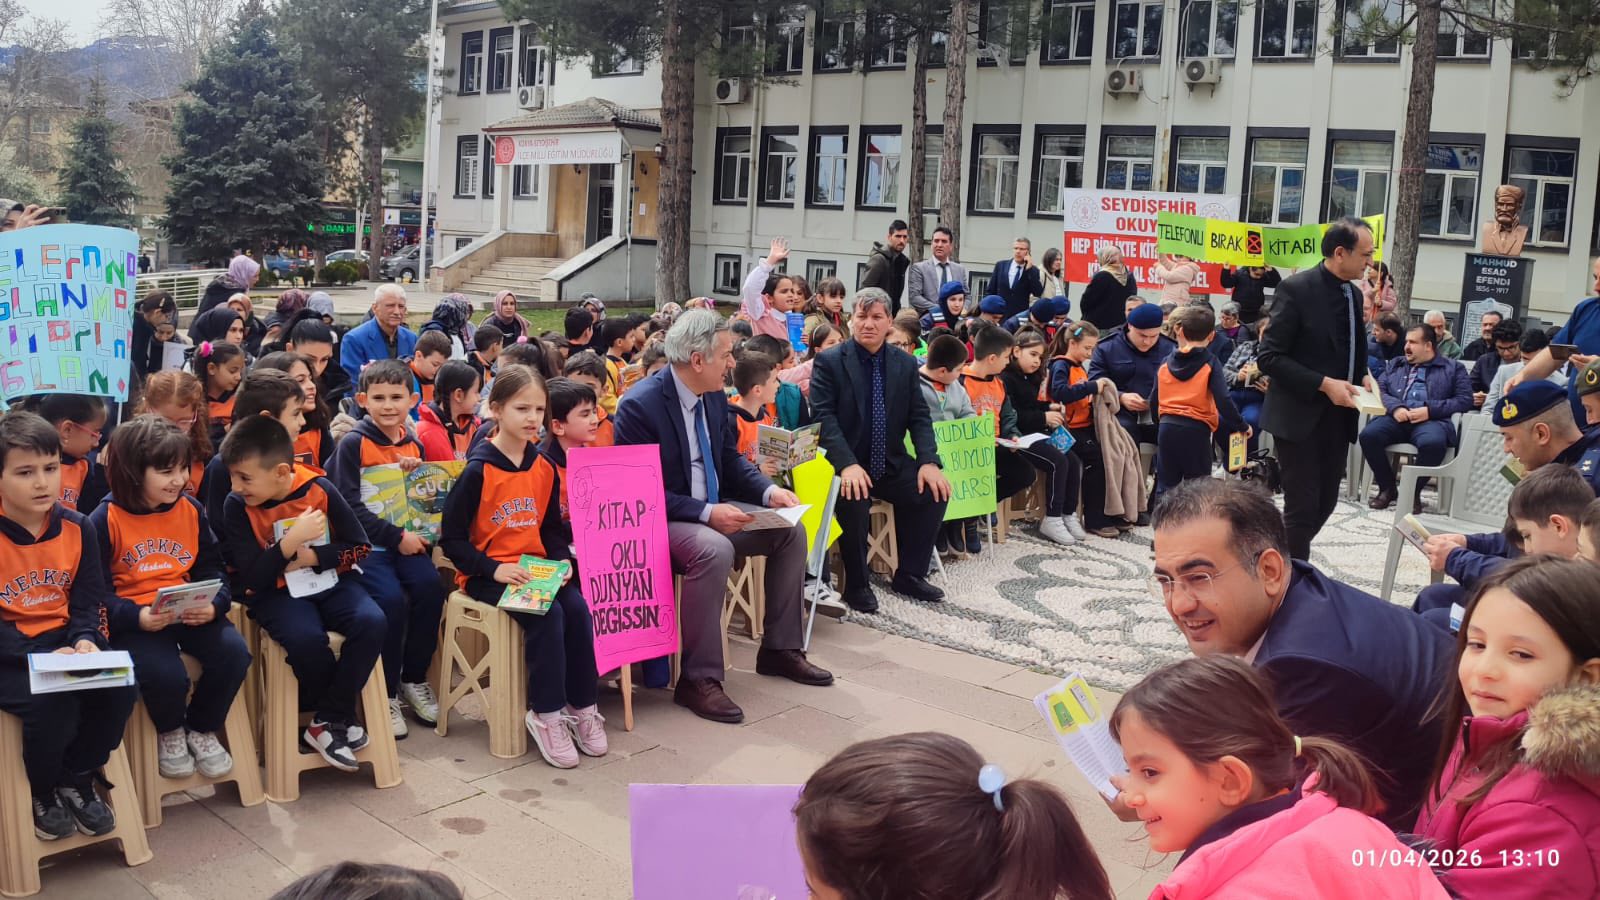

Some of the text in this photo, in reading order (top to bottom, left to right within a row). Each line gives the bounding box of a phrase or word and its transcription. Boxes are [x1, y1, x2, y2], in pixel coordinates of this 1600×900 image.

[1101, 196, 1197, 216] SEYDİŞEHİR
[1071, 237, 1091, 254] HEP
[1211, 232, 1243, 252] BIRAK
[1268, 235, 1316, 255] KİTABI
[1473, 257, 1518, 268] MAHMUD
[1481, 267, 1507, 277] ESAD
[598, 499, 647, 531] KİTAP
[120, 537, 193, 569] MERKEZ
[610, 539, 647, 571] OKU
